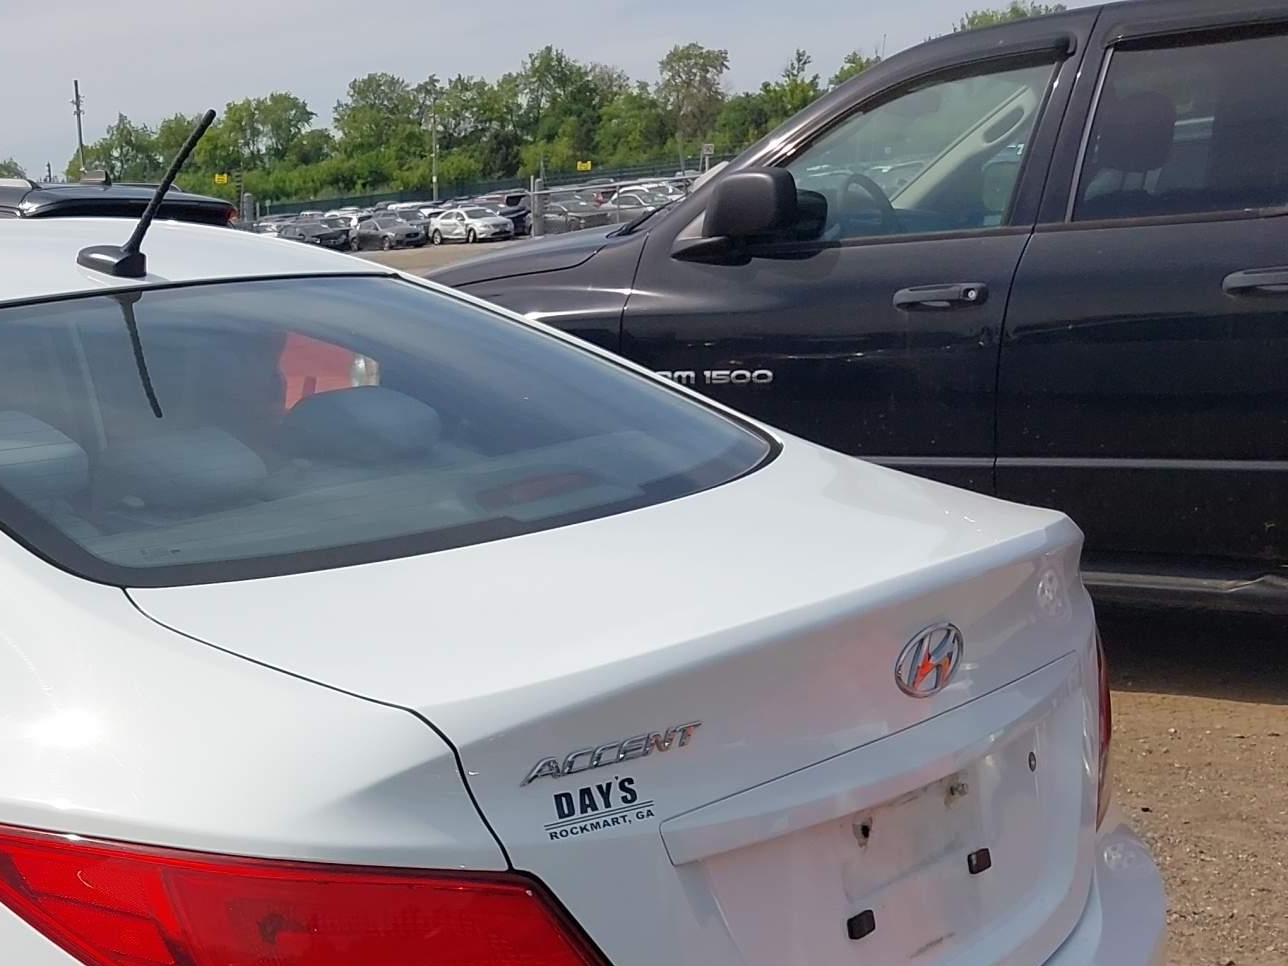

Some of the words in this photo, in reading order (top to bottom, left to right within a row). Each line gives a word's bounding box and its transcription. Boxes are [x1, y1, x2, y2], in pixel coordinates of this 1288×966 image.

[703, 369, 774, 384] 1500
[520, 720, 702, 787] ACCENT
[553, 775, 638, 820] DAY'S
[549, 814, 632, 840] ROCKMART,
[635, 809, 655, 821] GA
